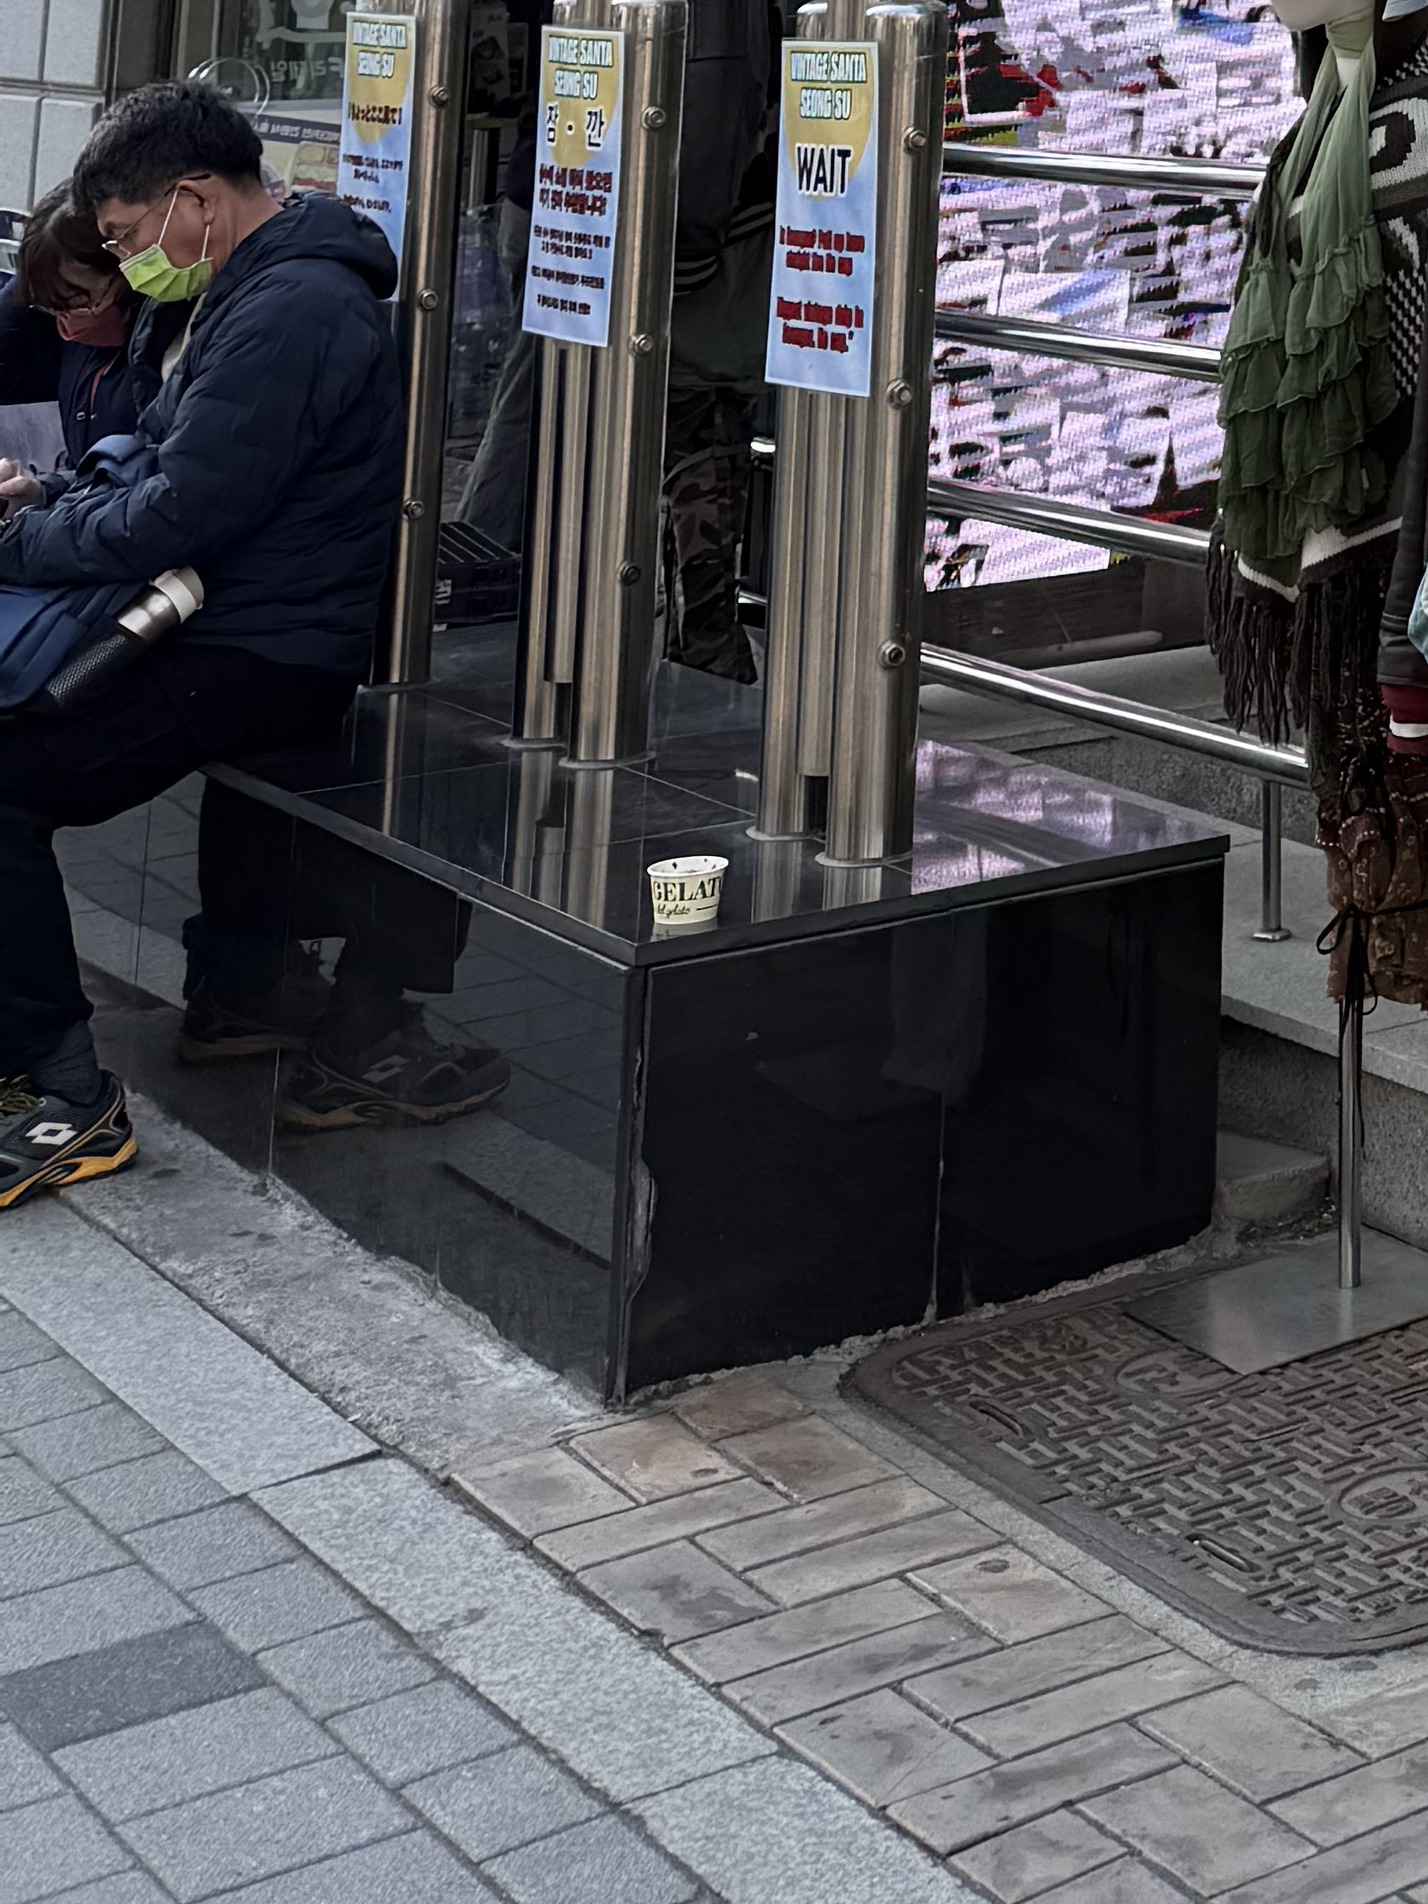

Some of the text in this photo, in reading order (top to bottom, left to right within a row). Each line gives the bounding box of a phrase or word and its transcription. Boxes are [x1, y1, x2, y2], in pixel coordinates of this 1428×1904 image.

[582, 71, 598, 100] SU
[834, 89, 852, 119] SU
[796, 145, 852, 195] WAIT
[653, 875, 723, 902] GELAT
